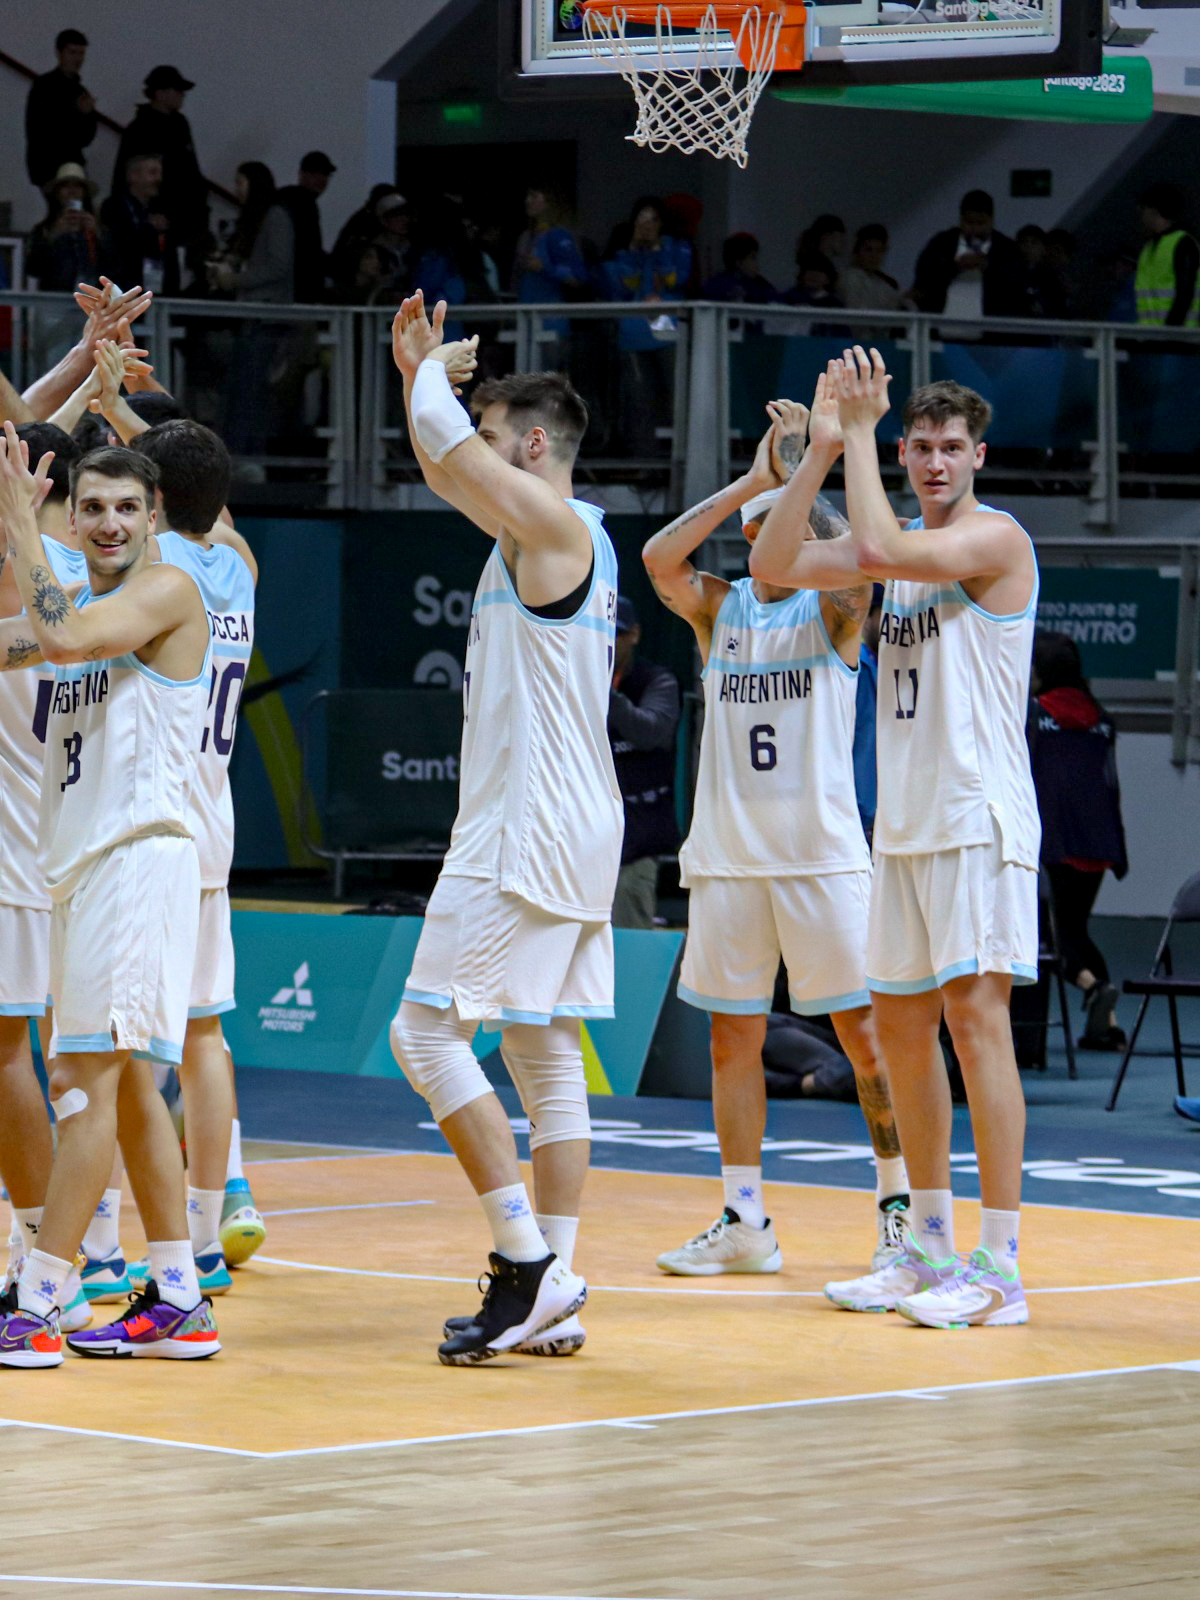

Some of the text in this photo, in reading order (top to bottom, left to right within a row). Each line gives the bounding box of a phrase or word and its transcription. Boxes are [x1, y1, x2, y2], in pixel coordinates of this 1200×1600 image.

[720, 669, 812, 704] ARGENTINA
[749, 724, 777, 771] 6
[258, 1006, 317, 1022] MITSUBISHI
[261, 1019, 305, 1033] MOTORS
